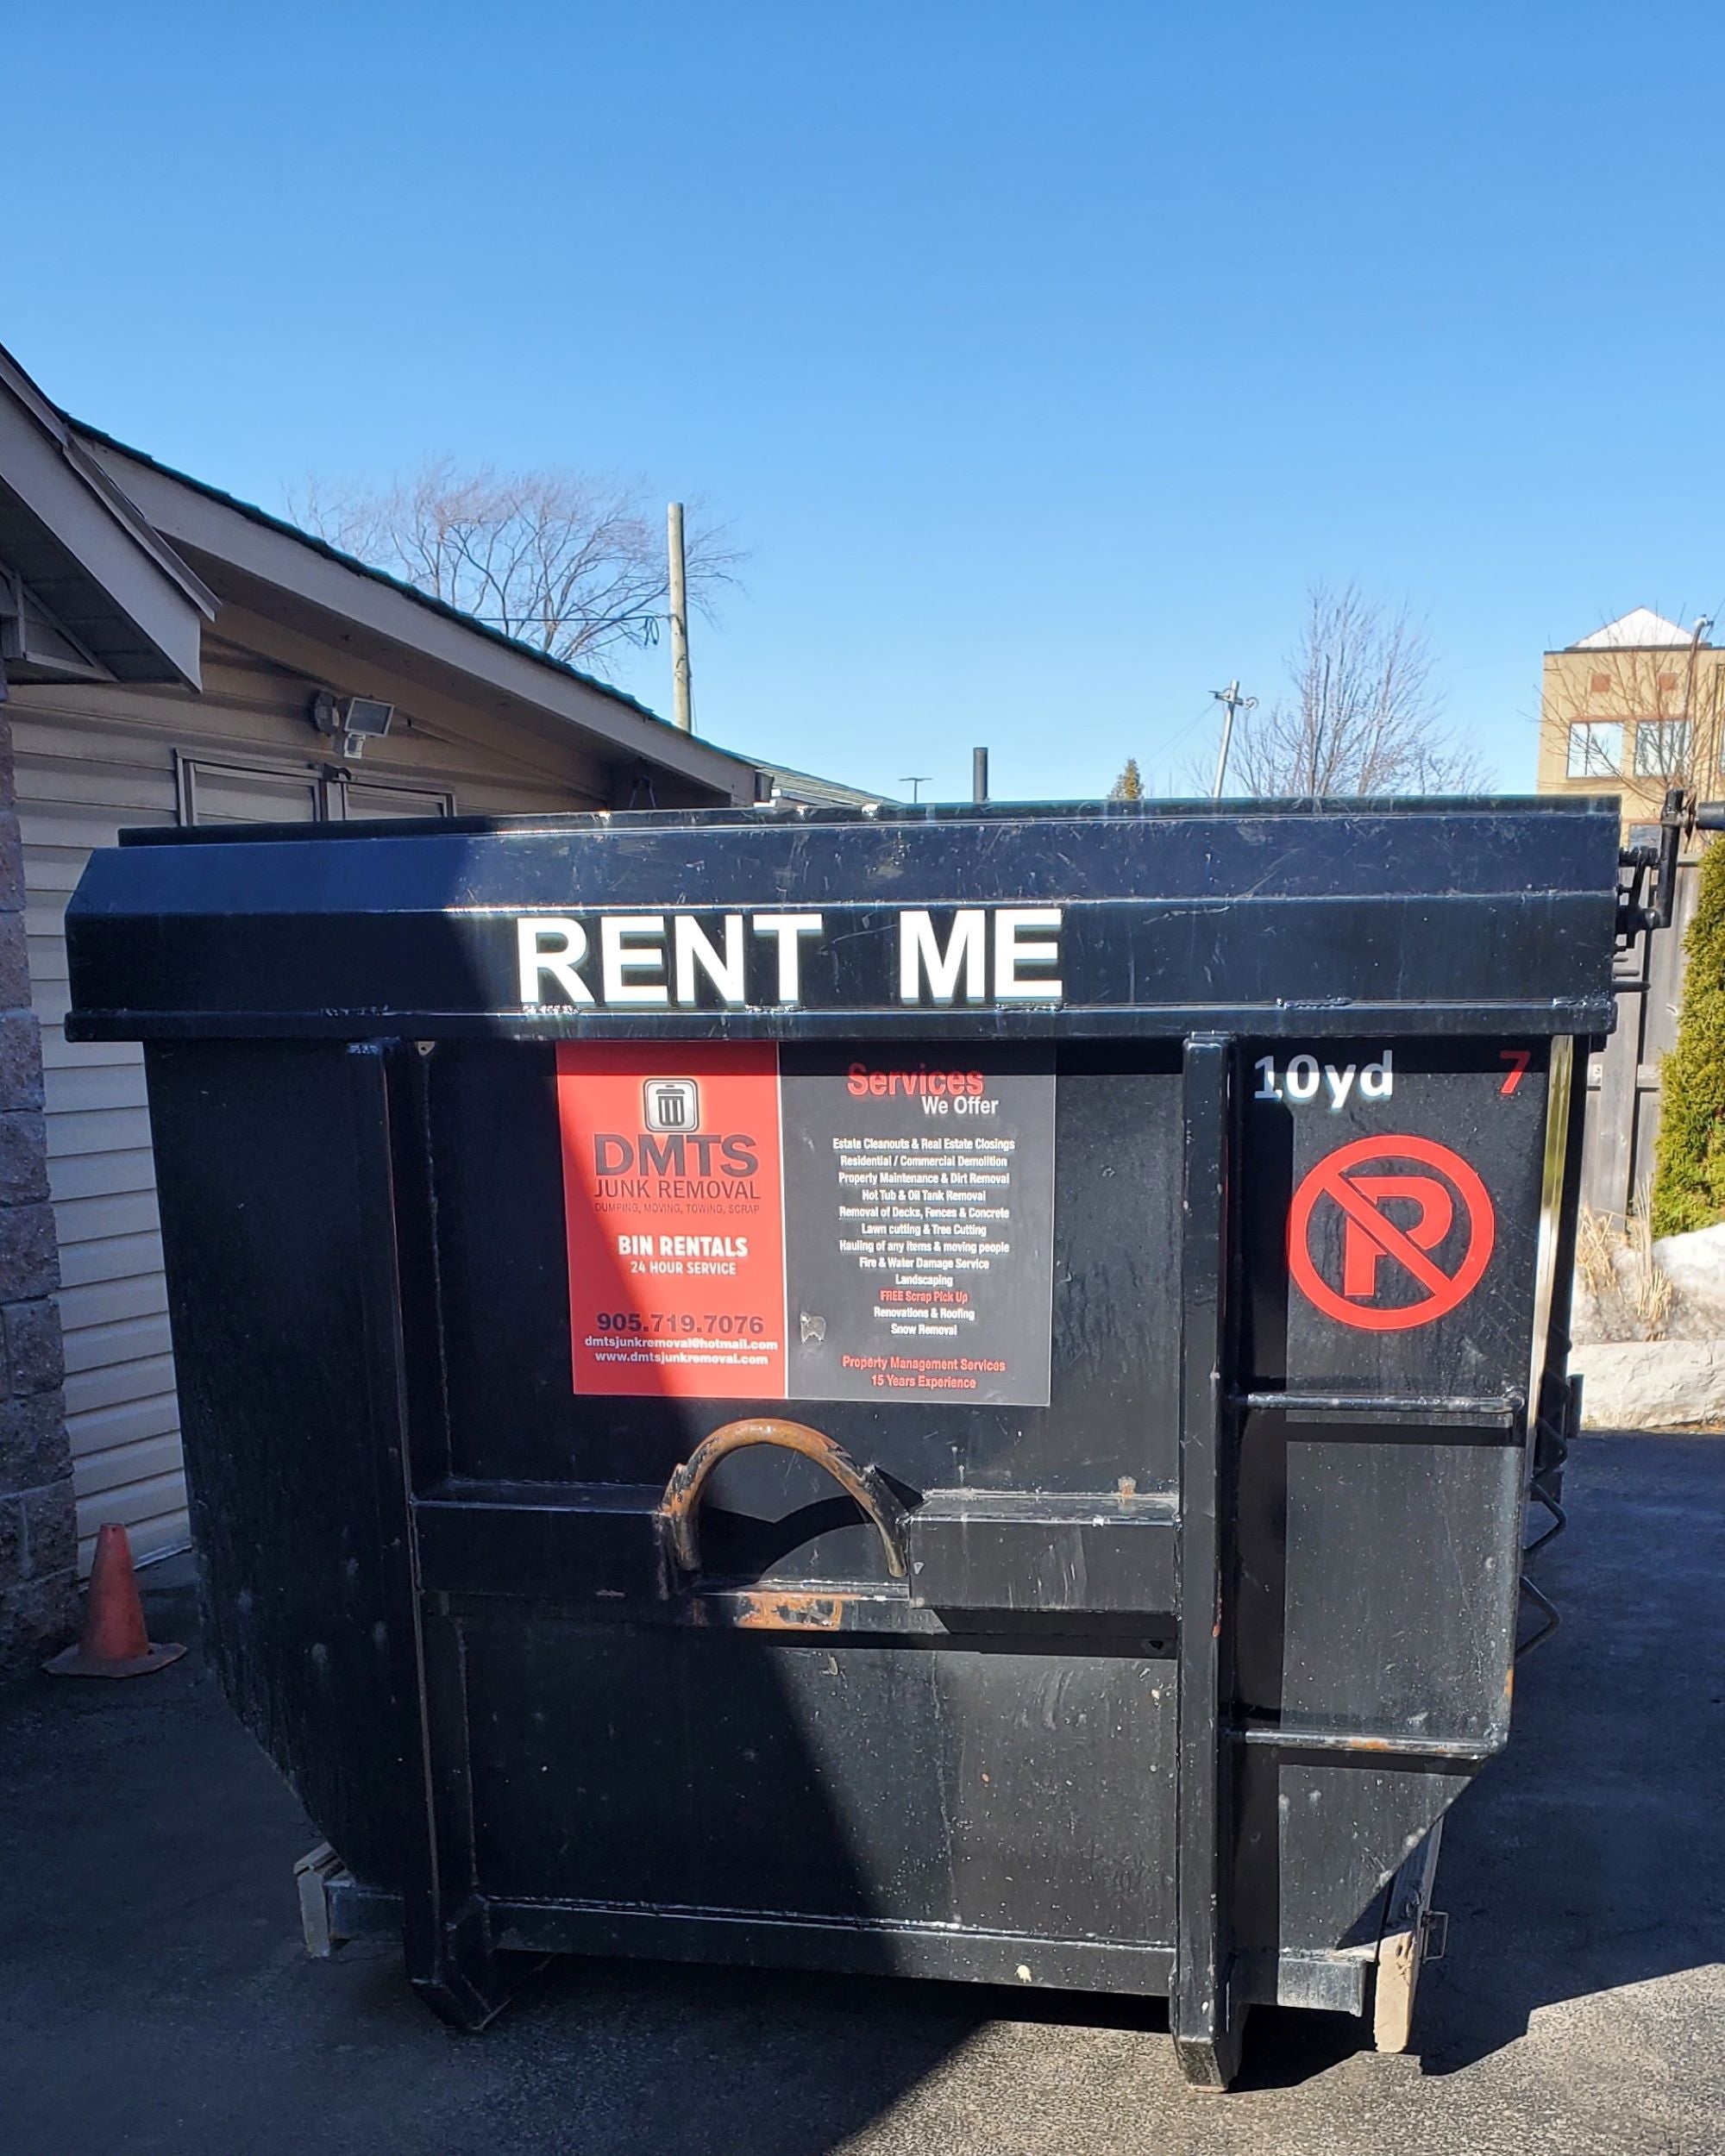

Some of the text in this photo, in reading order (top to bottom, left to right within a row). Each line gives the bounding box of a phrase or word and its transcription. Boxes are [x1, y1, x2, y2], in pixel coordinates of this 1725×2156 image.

[517, 908, 1063, 1004] RENT ME
[847, 1062, 983, 1095] Services
[1254, 1050, 1393, 1108] 10yd
[1499, 1051, 1531, 1094] 7
[921, 1096, 999, 1114] We Offer
[833, 1138, 1015, 1151] Estate Cleanouts & Real Estate Closings
[594, 1134, 759, 1177] DMTS
[841, 1156, 892, 1166] Residential
[900, 1156, 955, 1166] Commercial
[958, 1156, 1007, 1166] Demolition
[838, 1173, 1009, 1185] Property Maintenance & Dirt Removal
[594, 1180, 760, 1199] JUNK REMOVAL
[862, 1190, 986, 1200] Hot Tub & Oil Tank Removal
[729, 1204, 759, 1214] SCRAP
[839, 1206, 1009, 1219] Removal of Decks, Fences & Concrete
[862, 1223, 987, 1237] Lawn cutting & Tree Cutting
[618, 1235, 749, 1257] BIN RENTALS
[839, 1240, 1009, 1254] Hauling of any items & moving people
[630, 1262, 737, 1275] 24 HOUR SERVICE
[860, 1257, 989, 1271] Fire & Water Damage Service
[895, 1274, 953, 1287] Landscaping
[881, 1290, 968, 1304] FREE Scrap Pick Up
[874, 1307, 975, 1320] Renovations & Roofing
[597, 1313, 764, 1333] 905.719.7076
[891, 1324, 957, 1335] Snow Removal
[585, 1336, 778, 1350] dmtsjunkremoval@hotmail.com
[595, 1352, 768, 1364] www.dmtsjunkremoval.com
[842, 1356, 1006, 1371] Property Management Services
[871, 1376, 976, 1389] 15 Years Experience
